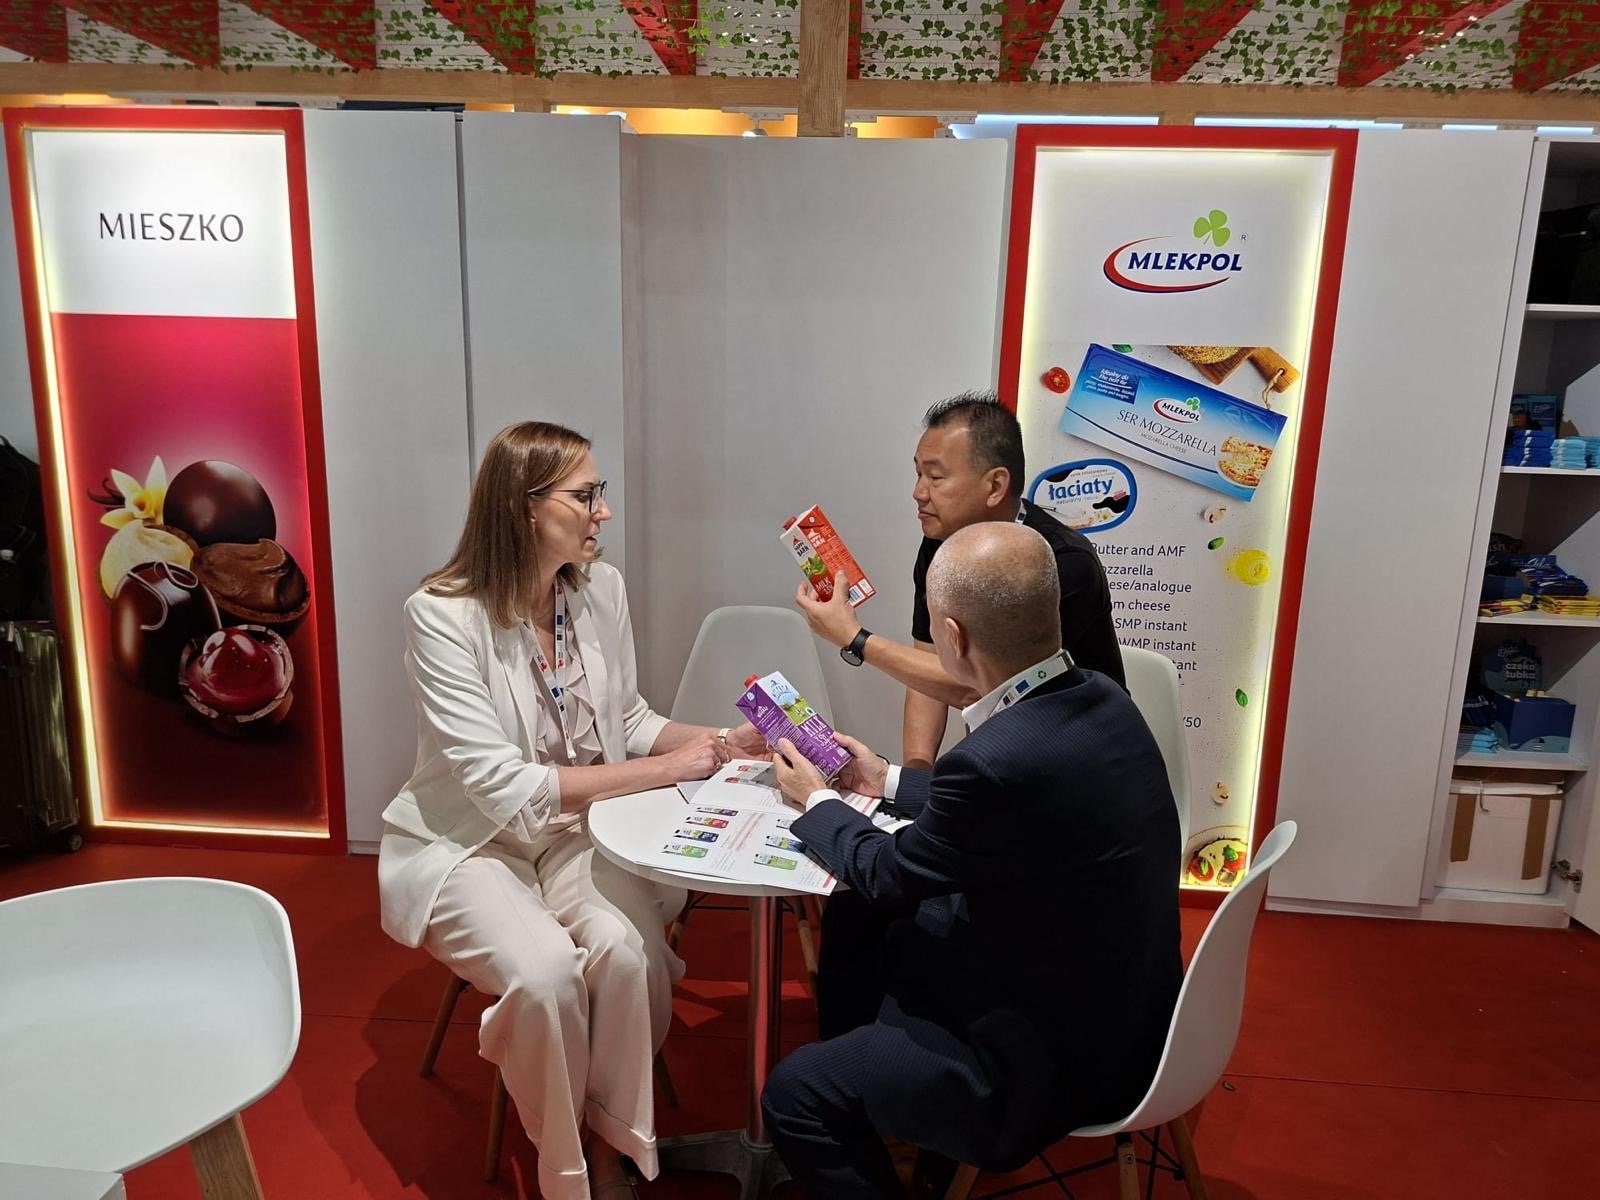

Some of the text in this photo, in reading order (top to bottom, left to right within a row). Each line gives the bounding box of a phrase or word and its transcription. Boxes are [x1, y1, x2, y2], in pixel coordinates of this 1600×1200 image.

[99, 212, 244, 243] MIESZKO
[1128, 252, 1243, 272] MLEKPOL
[1162, 402, 1201, 422] MLEKPOL
[1117, 409, 1217, 457] SER MOZZARELLA
[1048, 478, 1113, 501] łaciaty
[1090, 542, 1187, 557] Butter and AMF
[1102, 564, 1154, 576] ozzarella
[1109, 580, 1192, 595] ese/analogue
[1128, 598, 1171, 611] cheese
[1115, 618, 1188, 632] SMP instant
[1119, 637, 1197, 652] WMP instant
[800, 715, 828, 738] MILK
